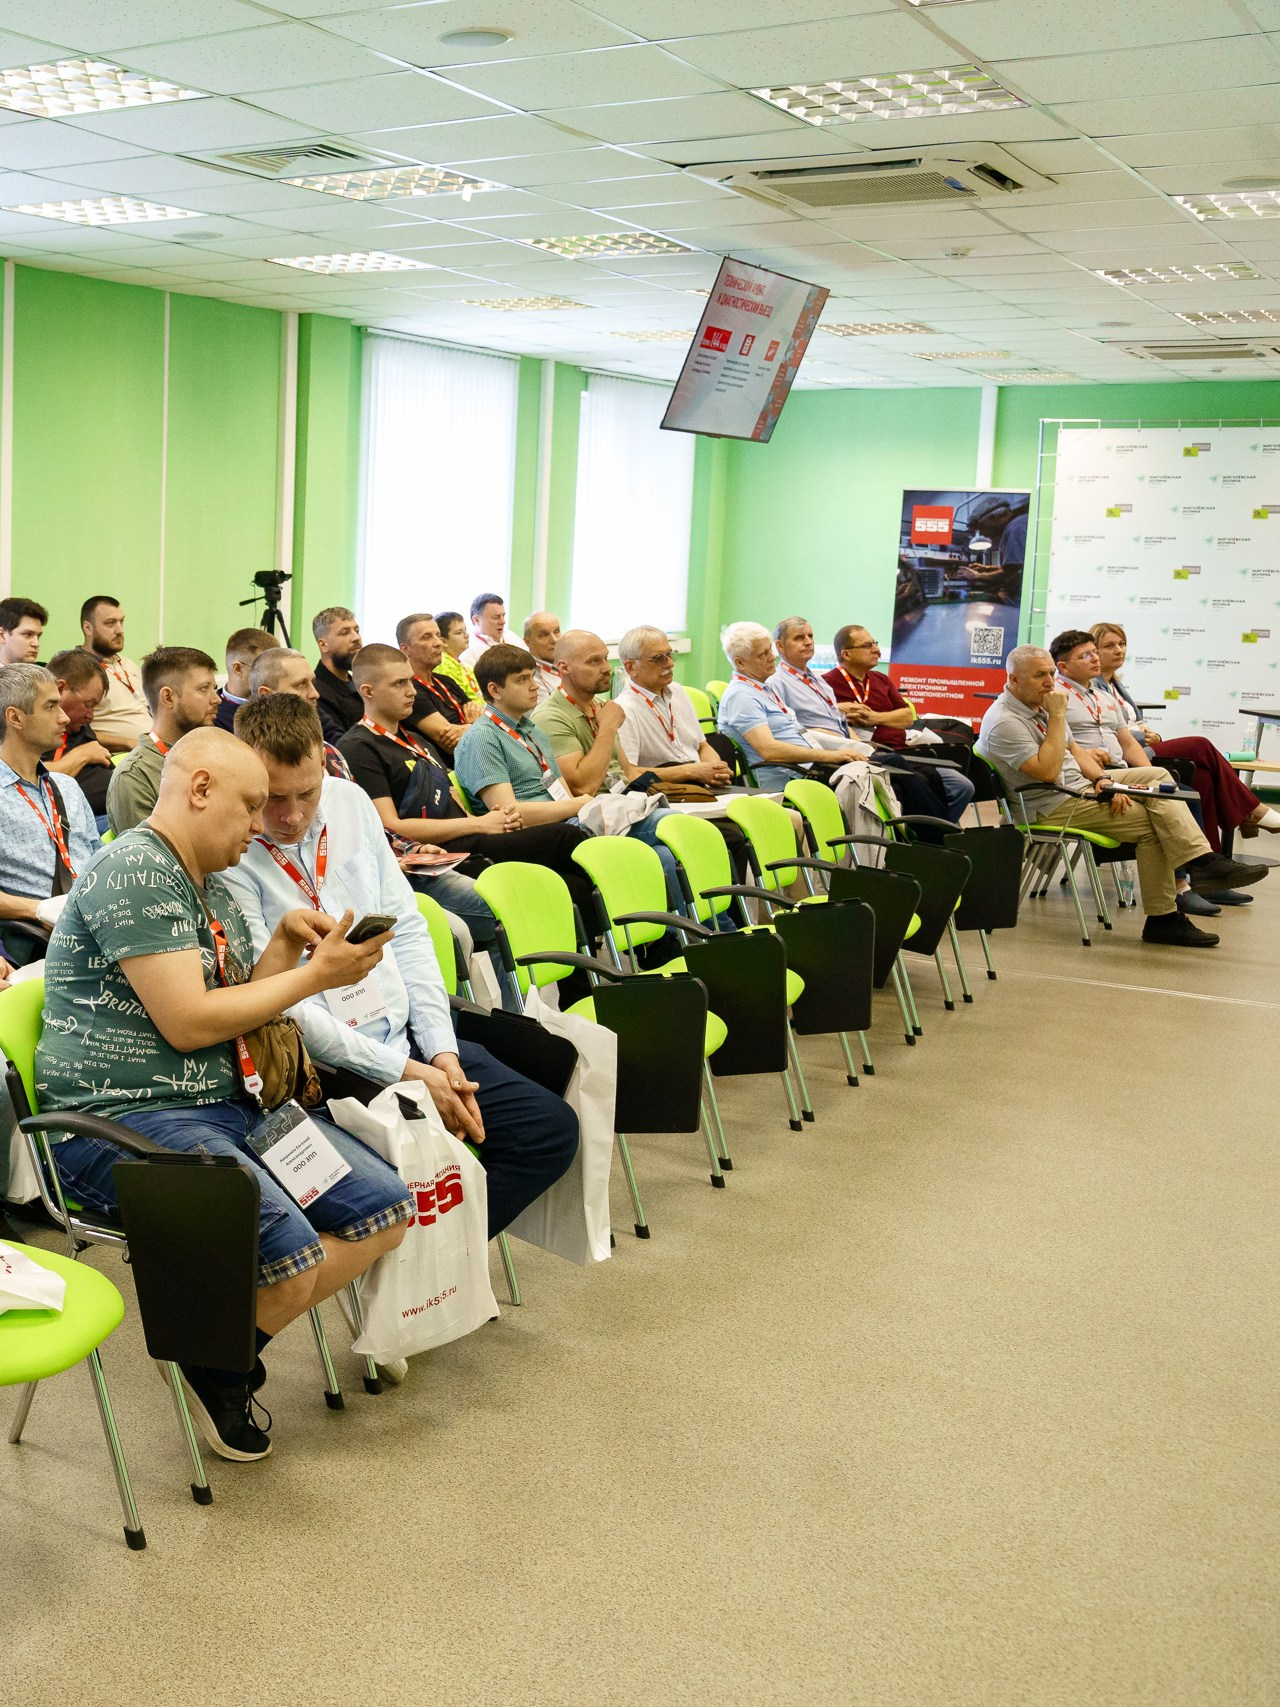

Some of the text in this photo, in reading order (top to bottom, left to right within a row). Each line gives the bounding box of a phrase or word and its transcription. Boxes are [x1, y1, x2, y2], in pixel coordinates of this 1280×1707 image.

[915, 518, 950, 533] 555
[970, 656, 1001, 665] ik555.ru
[899, 683, 948, 692] ЭЛЕКТРОНИКИ
[900, 676, 985, 687] РЕМОНТ ПРОМЫШЛЕННОЙ
[909, 691, 964, 699] КОМПОНЕНТНОМ
[270, 847, 288, 866] 555
[299, 879, 314, 898] 555
[341, 988, 366, 1002] ООО ЗПП
[118, 1028, 137, 1036] FROM
[139, 1031, 157, 1039] THAT
[113, 1036, 134, 1044] NEVER
[101, 1043, 145, 1055] MATTER
[89, 1051, 119, 1060] BELIEVE
[293, 1151, 318, 1173] ООО ЗПП
[299, 1187, 319, 1206] 555
[407, 1173, 464, 1228] 55
[401, 1285, 458, 1319] www.ik55.ru
